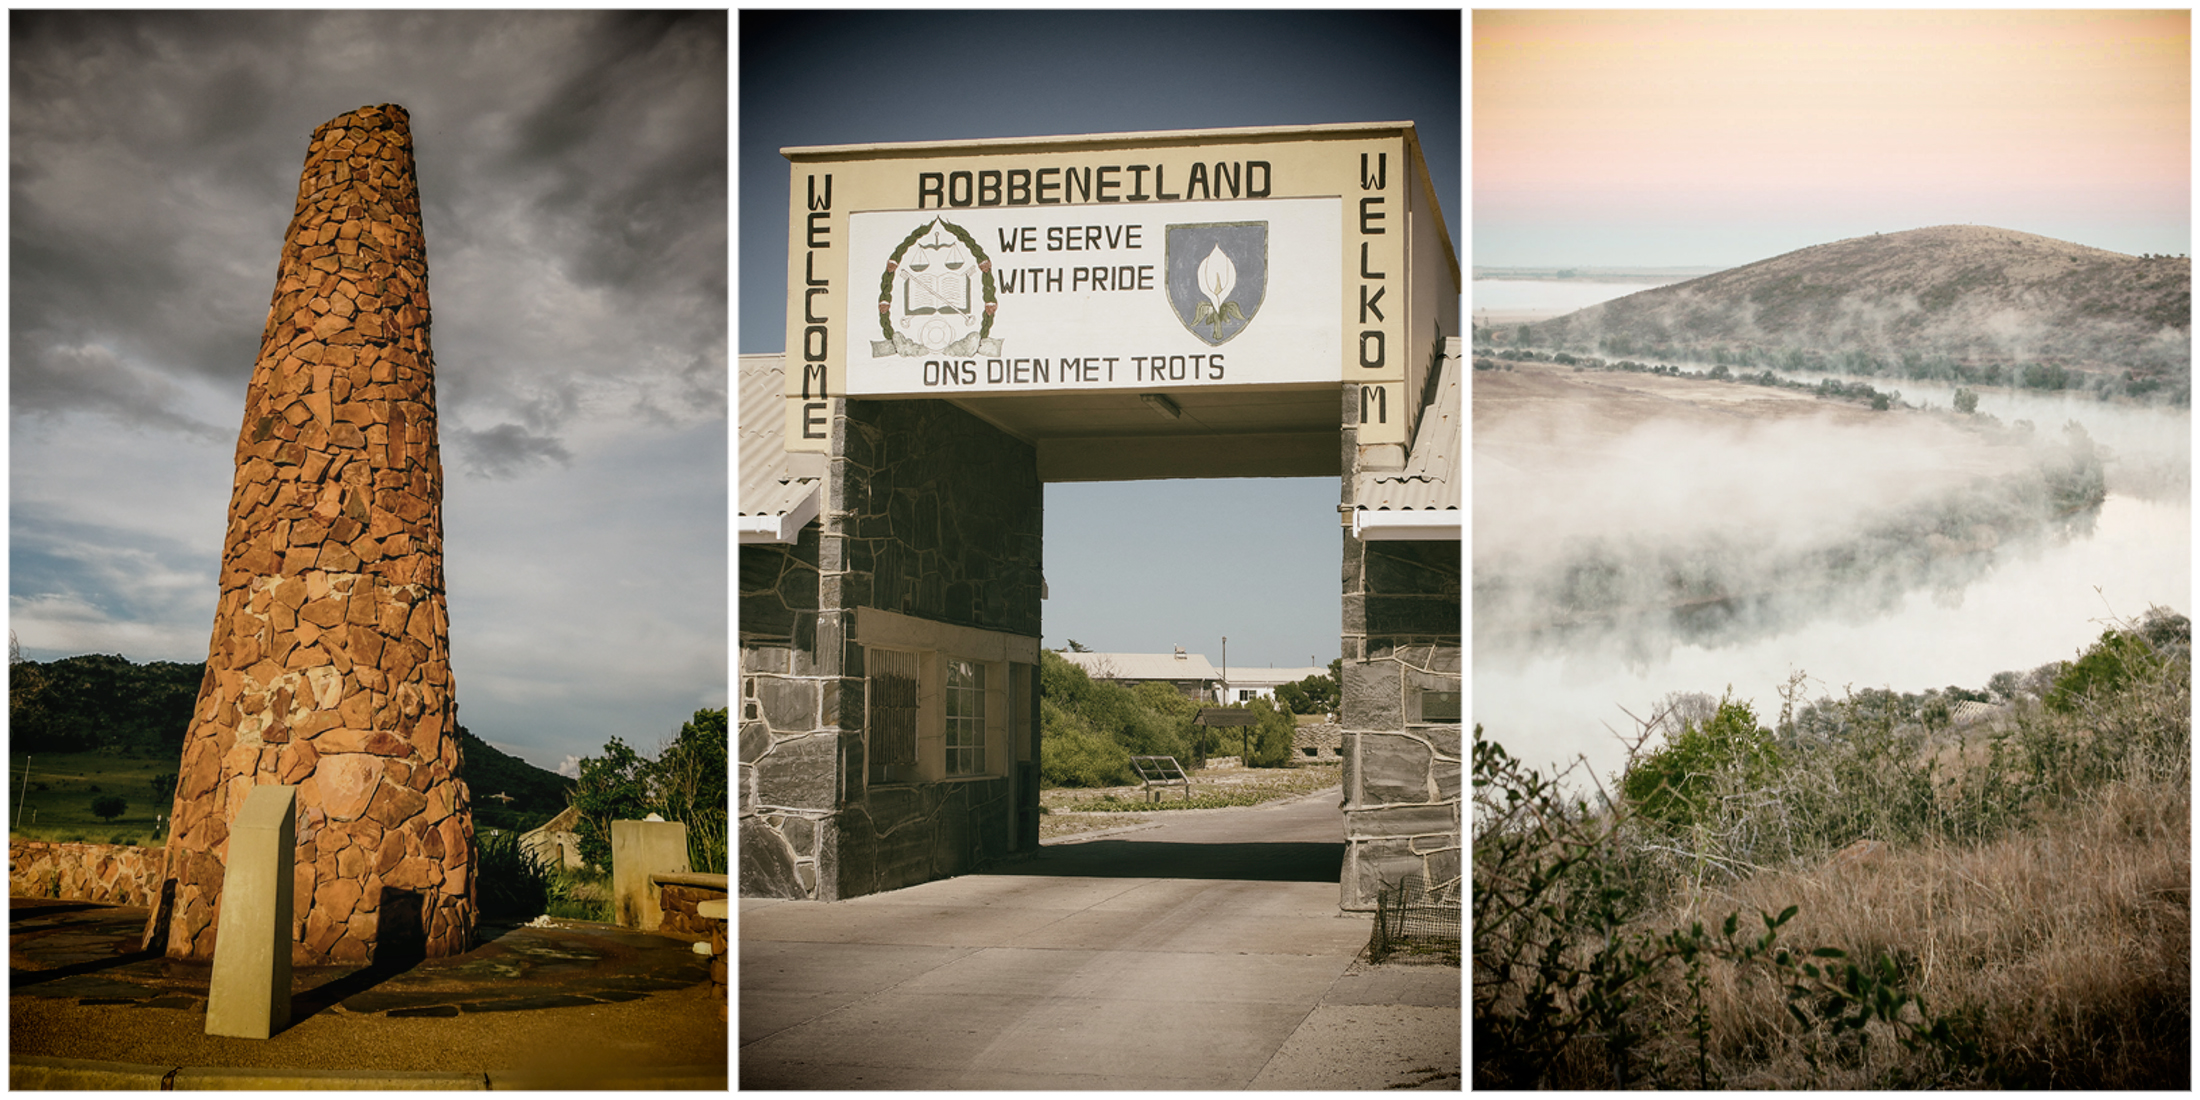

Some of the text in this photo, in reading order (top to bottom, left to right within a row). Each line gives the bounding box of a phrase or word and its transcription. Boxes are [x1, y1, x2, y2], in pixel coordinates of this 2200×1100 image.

[918, 160, 1272, 209] ROBBENEILAND
[998, 224, 1142, 253] WE SERVE
[998, 265, 1155, 294] WITH PRIDE
[1359, 152, 1387, 424] WELKOM
[801, 173, 833, 439] WELCOME
[923, 354, 1225, 386] ONS DIEN MET TROTS
